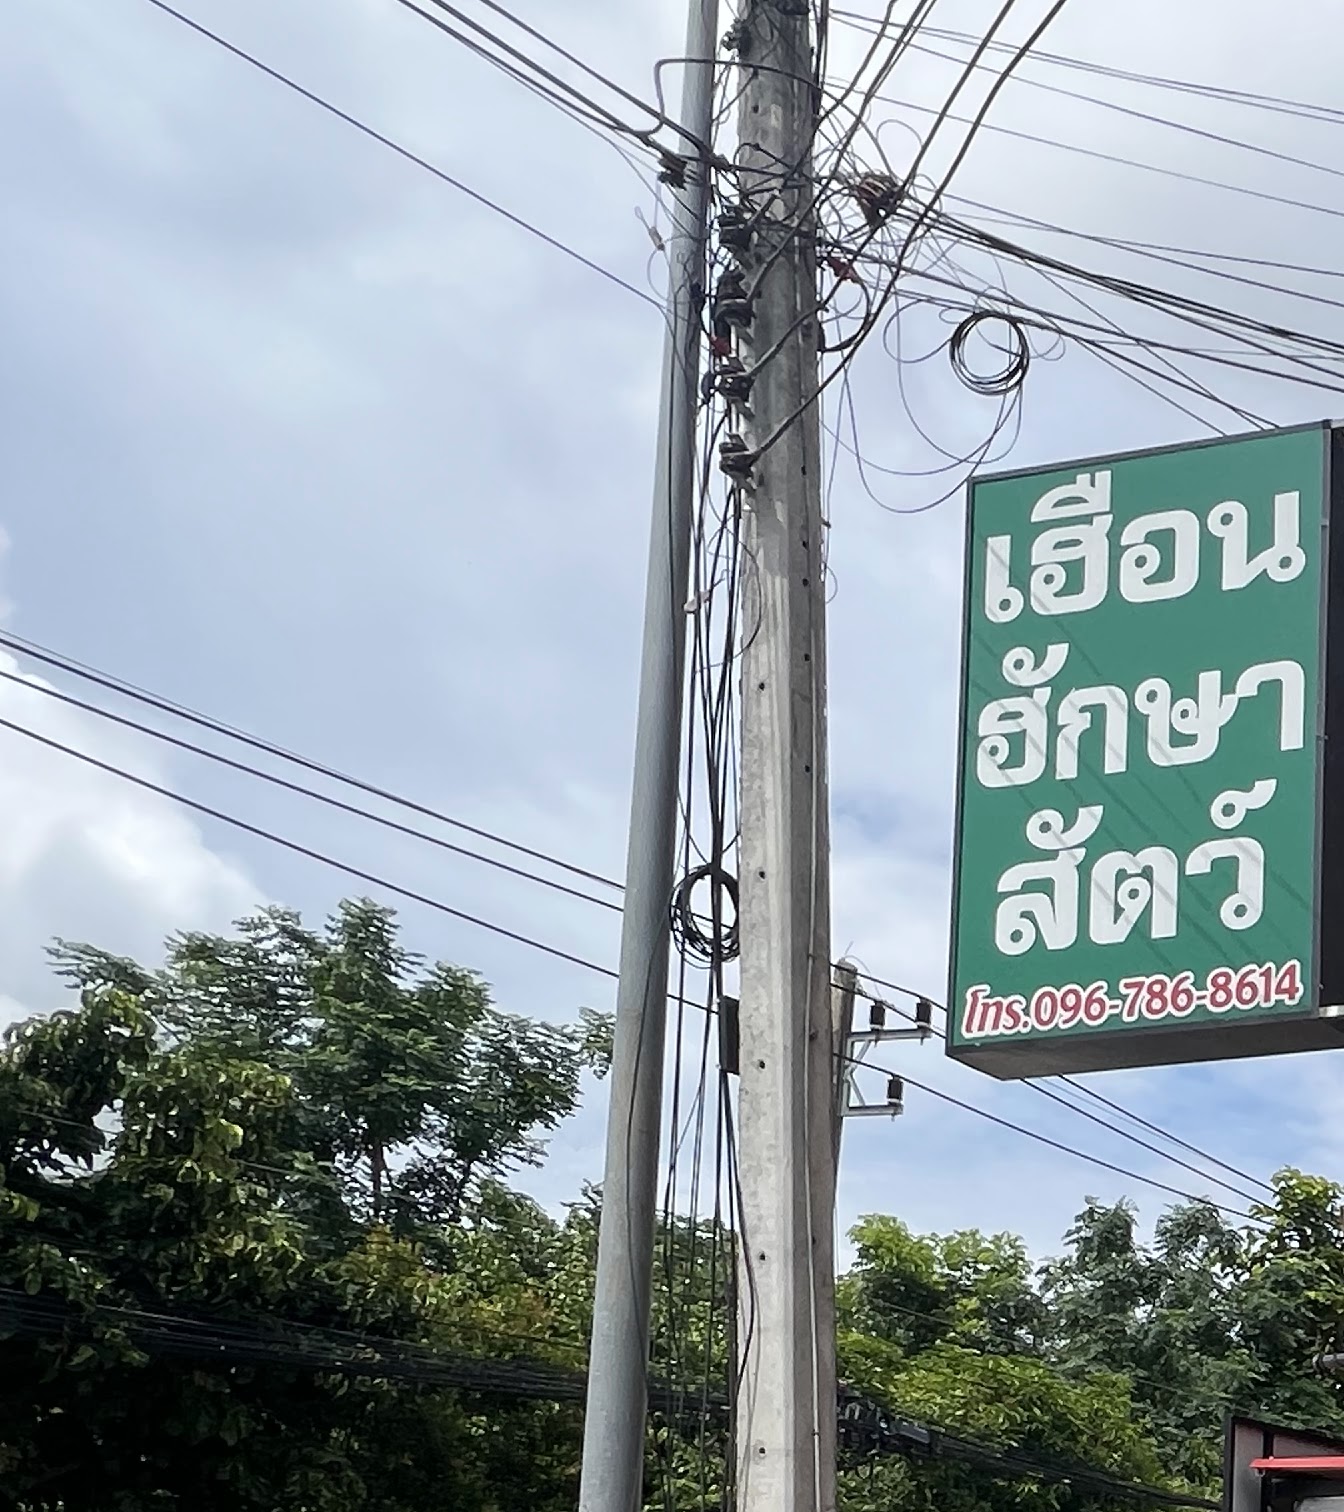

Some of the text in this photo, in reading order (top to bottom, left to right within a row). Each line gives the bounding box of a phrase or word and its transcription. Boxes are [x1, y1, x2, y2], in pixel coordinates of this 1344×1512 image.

[984, 469, 1306, 623] เฮือน
[976, 643, 1305, 788] ฮักษา
[994, 778, 1278, 956] สัตว์
[963, 963, 1301, 1036] โทร.096-786-8614
